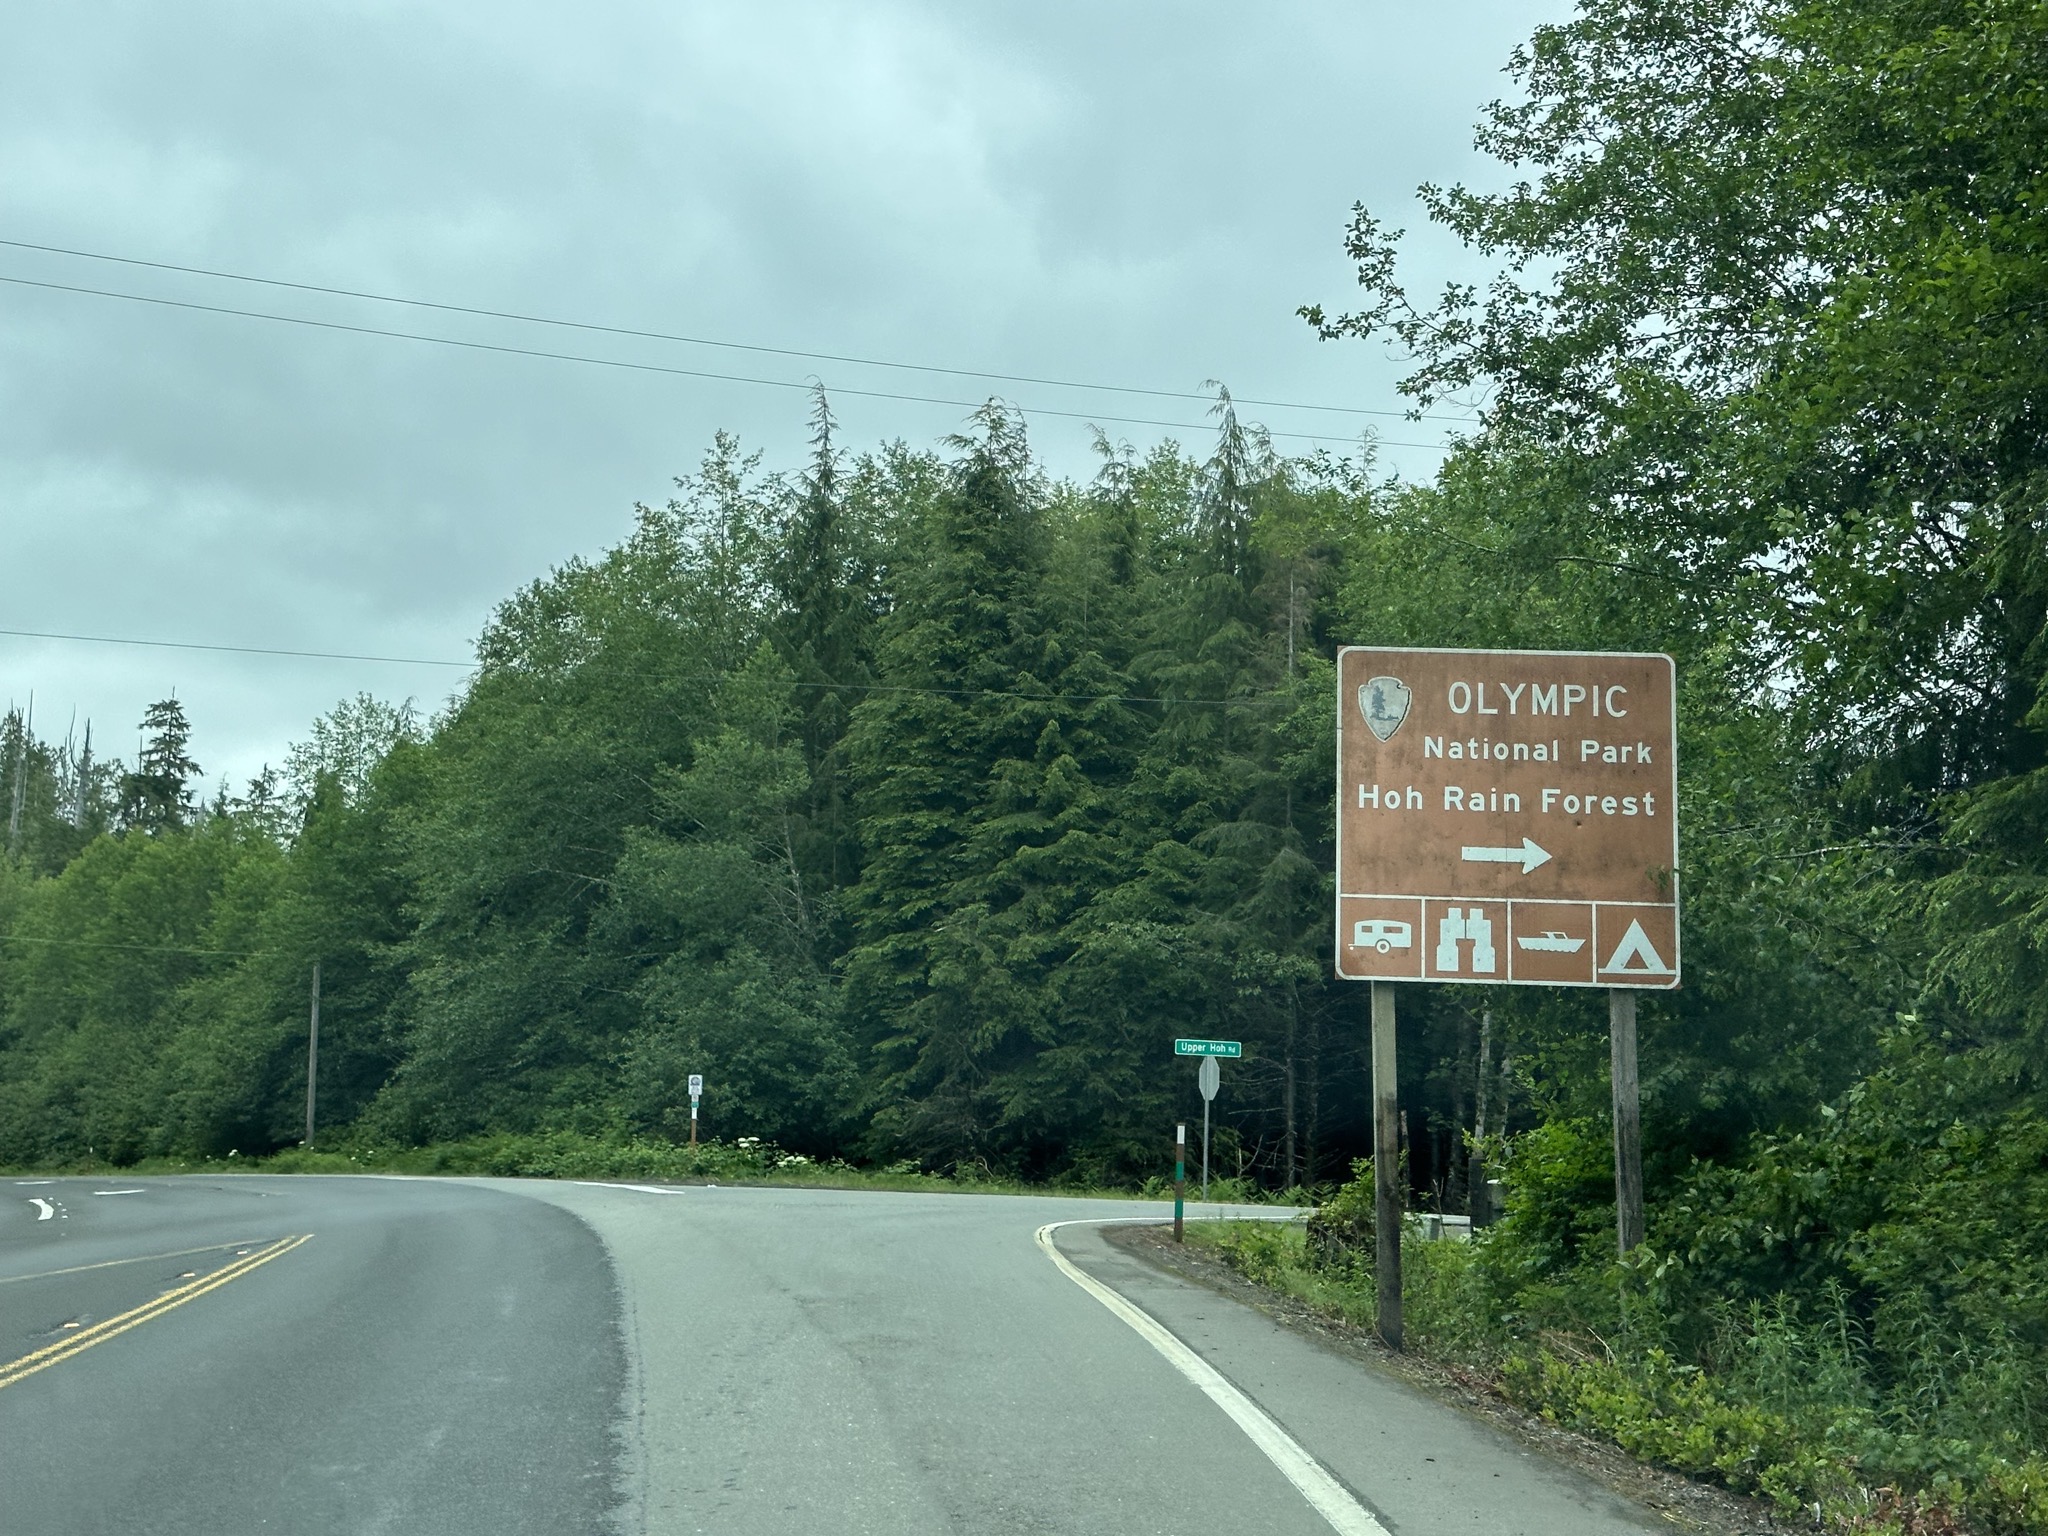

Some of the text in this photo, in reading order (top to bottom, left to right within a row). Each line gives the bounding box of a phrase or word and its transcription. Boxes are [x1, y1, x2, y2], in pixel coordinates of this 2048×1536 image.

[1448, 681, 1628, 718] OLYMPIC
[1424, 736, 1652, 764] National Park
[1358, 784, 1655, 816] Hoh Rain Forest
[1181, 1042, 1206, 1053] Upper
[1210, 1043, 1226, 1052] Hoh
